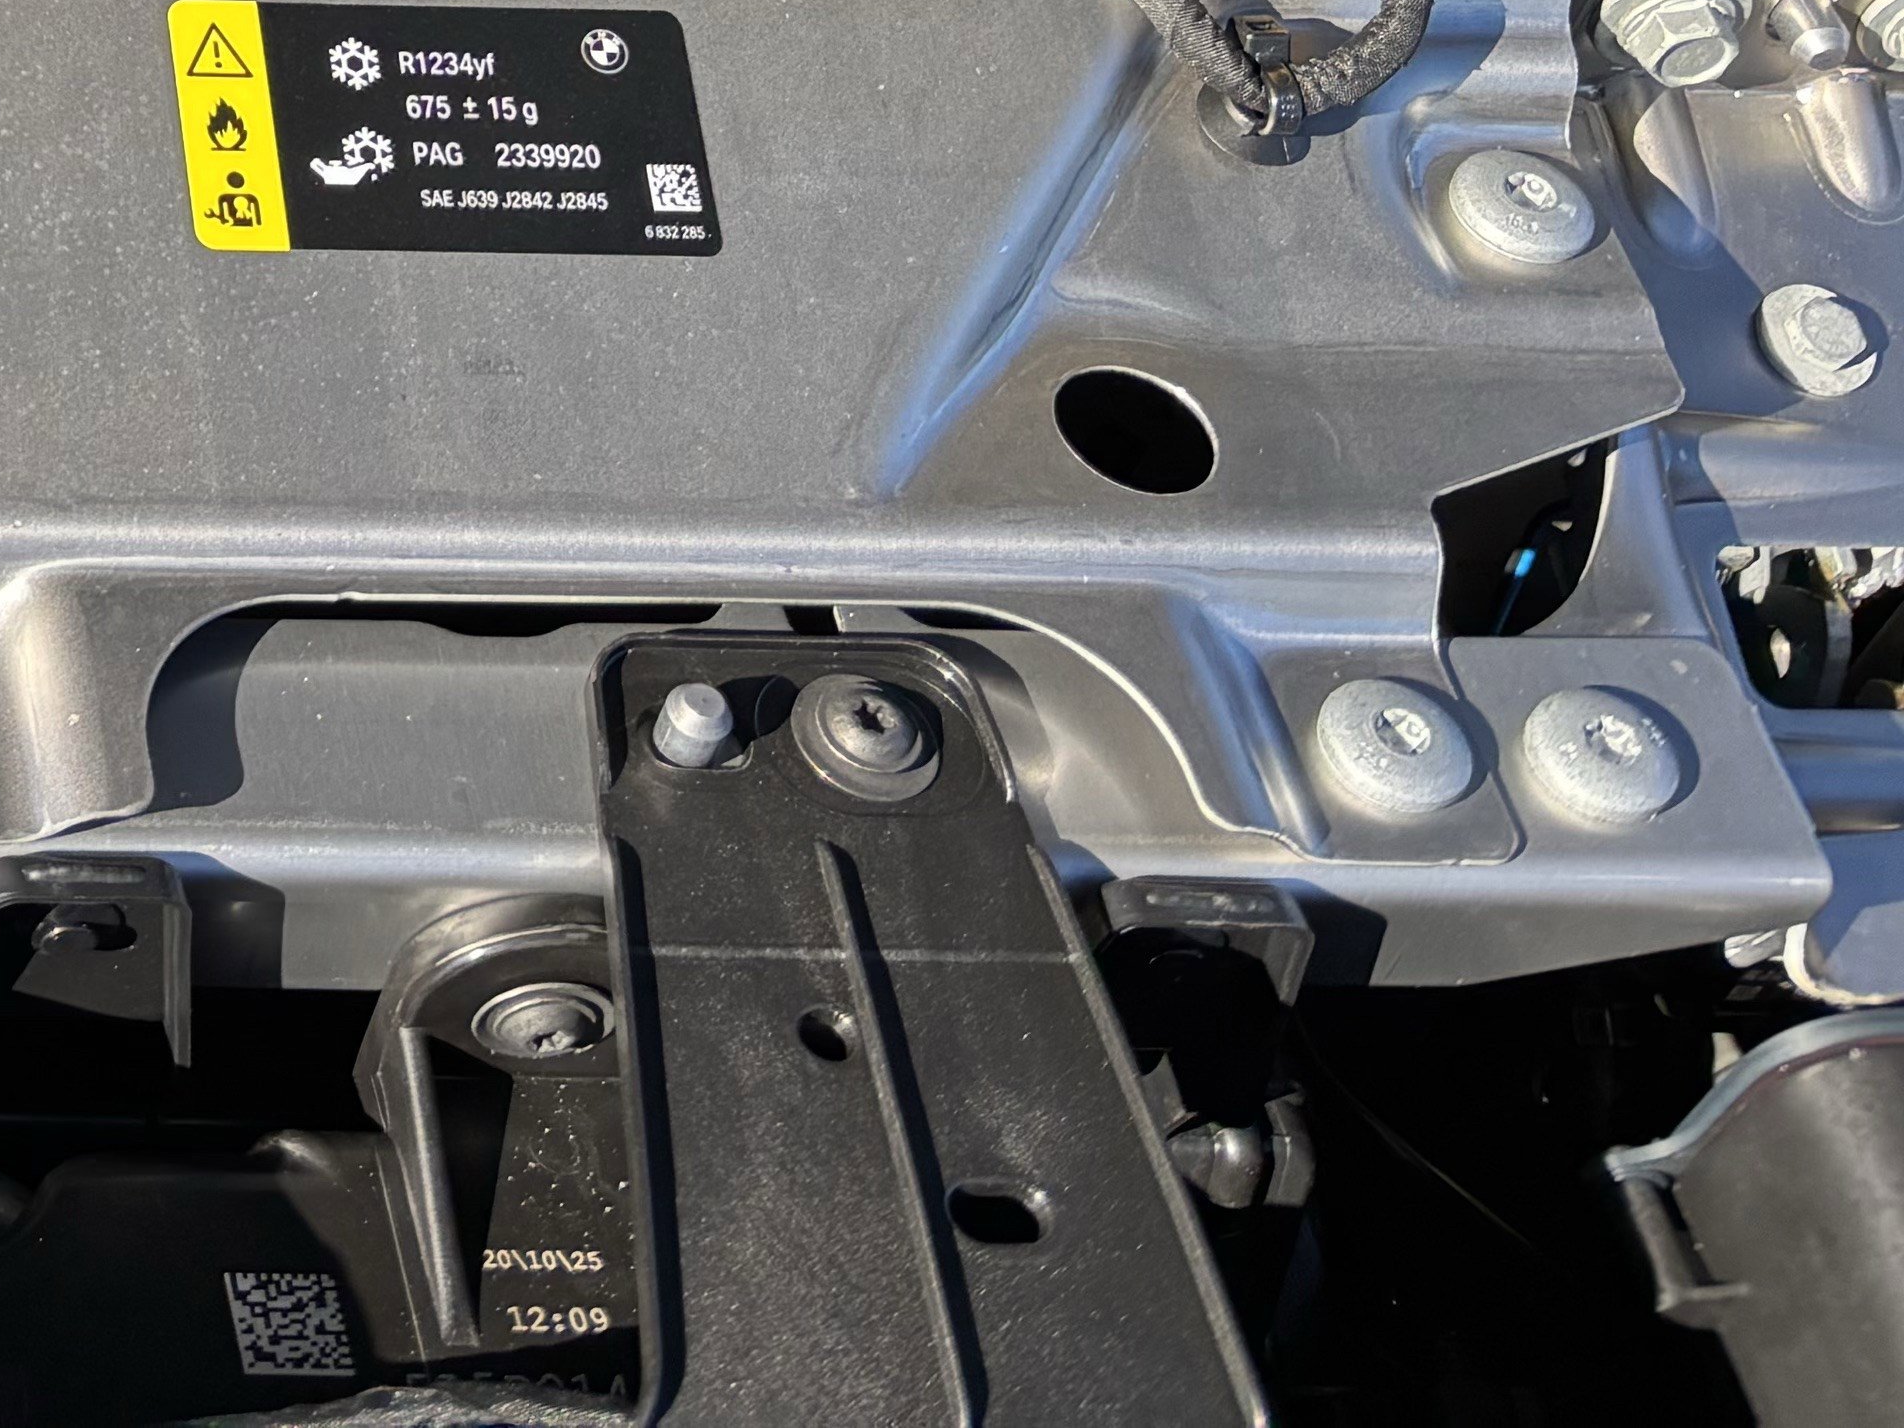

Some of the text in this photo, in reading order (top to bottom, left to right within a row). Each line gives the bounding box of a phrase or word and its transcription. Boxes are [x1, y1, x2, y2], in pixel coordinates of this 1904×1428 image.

[399, 51, 494, 80] R1234yf
[406, 95, 538, 125] 675 ± 15 g
[413, 142, 600, 168] PAG 2339920
[421, 189, 608, 210] SAE J639 J2842 J2845
[645, 225, 654, 238] 6
[655, 225, 680, 239] 832
[483, 1249, 605, 1272] 20\10\25
[506, 1306, 609, 1333] 12:09
